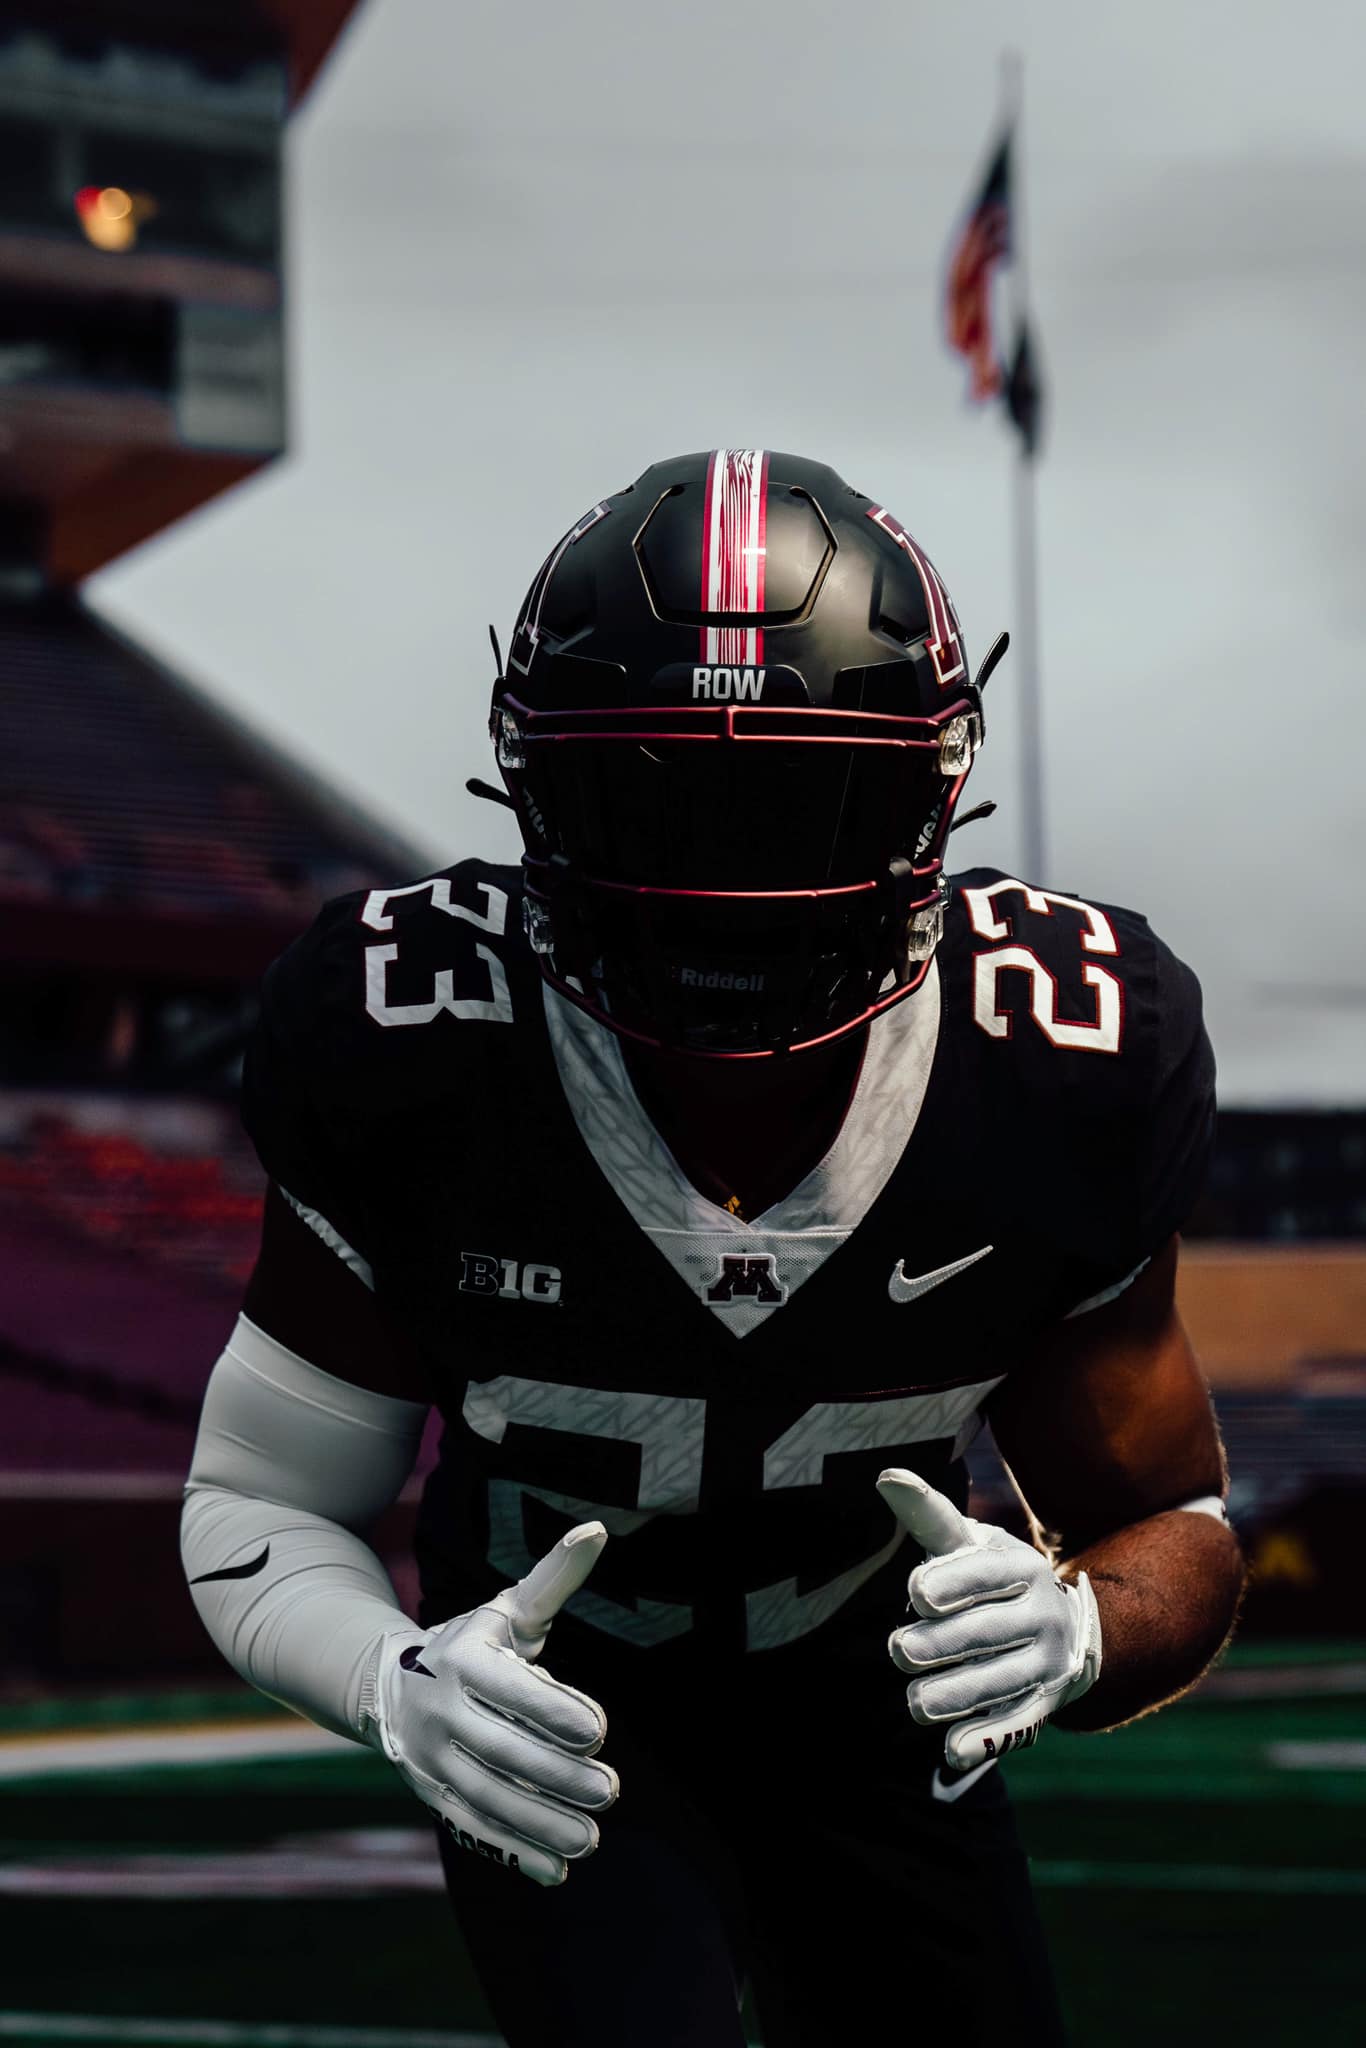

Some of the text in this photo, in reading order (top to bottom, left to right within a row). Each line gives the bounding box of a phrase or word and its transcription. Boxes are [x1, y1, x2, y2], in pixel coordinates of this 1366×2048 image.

[692, 667, 766, 700] ROW
[681, 967, 765, 992] Riddell
[965, 876, 1123, 1056] 23
